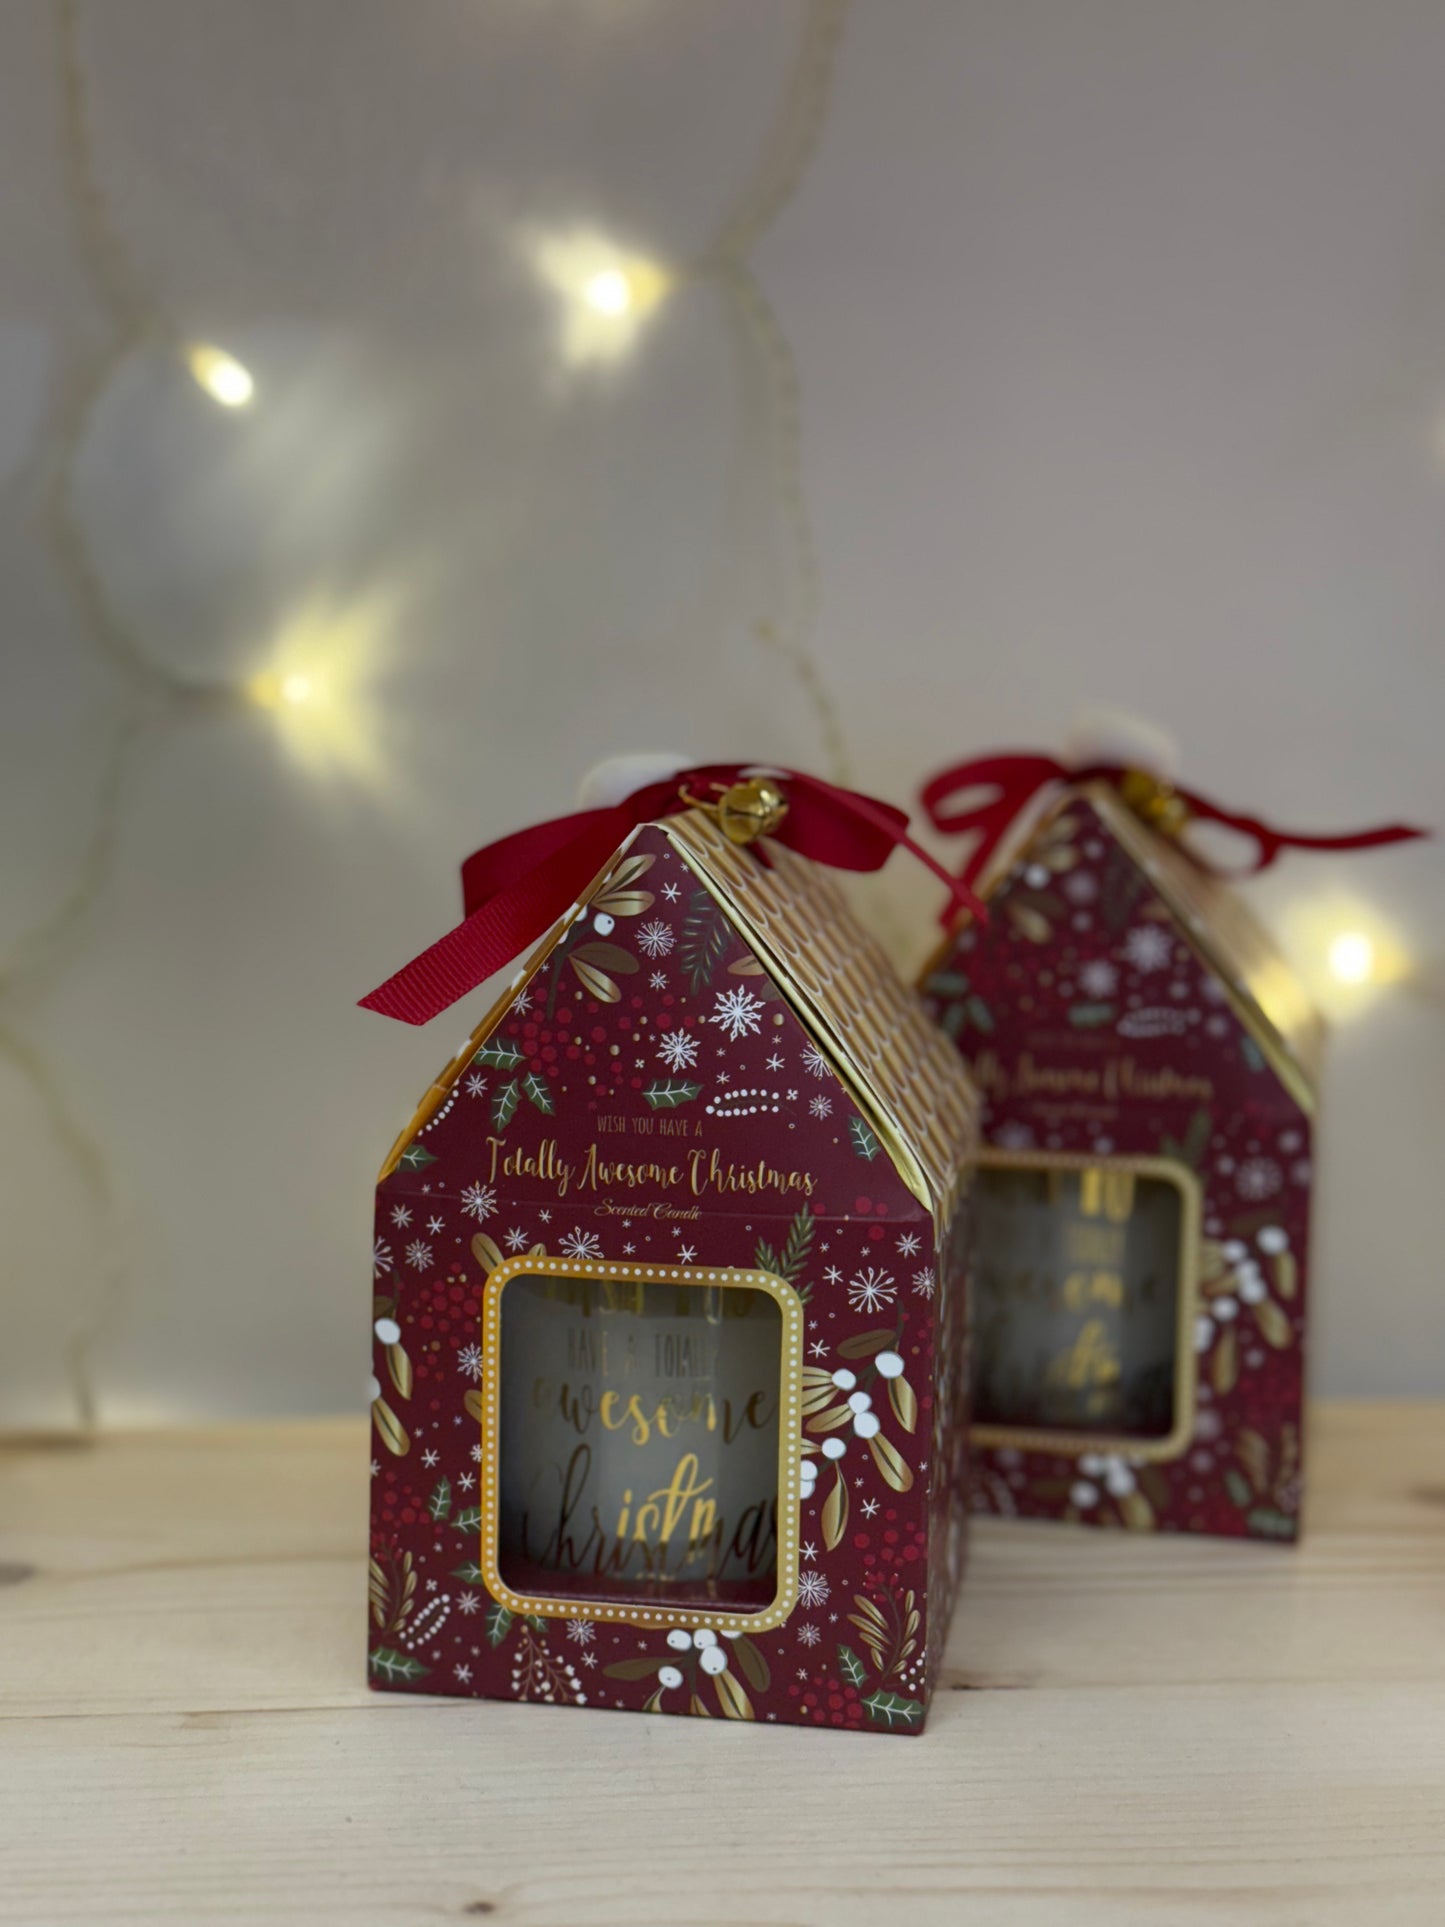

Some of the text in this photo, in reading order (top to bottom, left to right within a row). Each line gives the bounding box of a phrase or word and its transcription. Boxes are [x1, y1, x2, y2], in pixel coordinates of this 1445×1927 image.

[597, 1115, 703, 1136] WISH YOU HAVE A
[486, 1137, 817, 1198] Totally Awesome Christmas
[594, 1198, 701, 1220] Scented Candle
